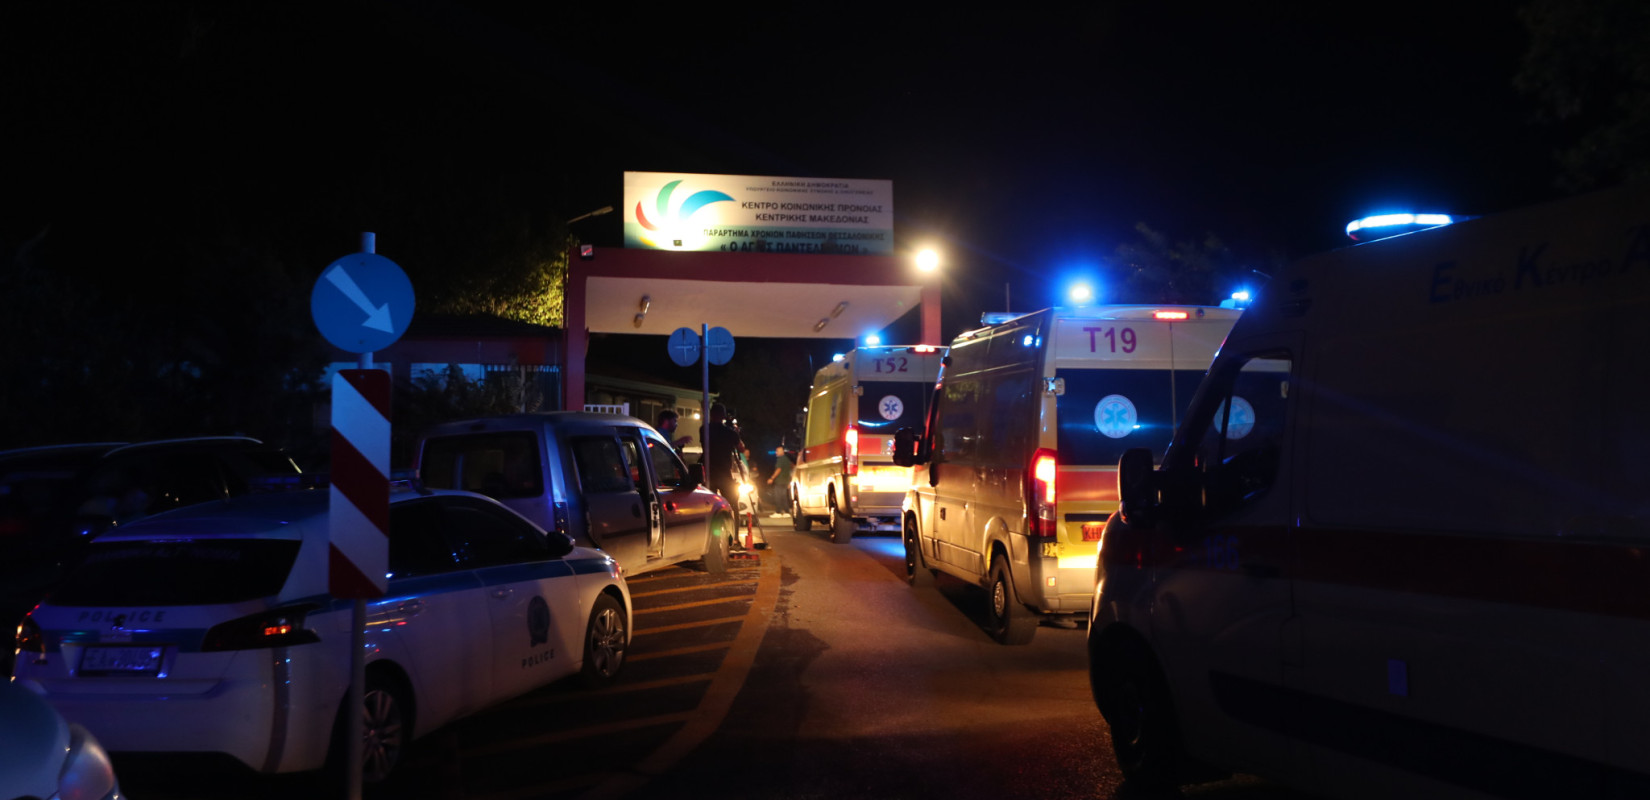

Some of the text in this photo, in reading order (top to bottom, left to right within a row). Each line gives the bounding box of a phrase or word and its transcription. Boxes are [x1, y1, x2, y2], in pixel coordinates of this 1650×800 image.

[742, 202, 883, 213] ΚΕΝΤΡΟ ΚΟΙΝΩΝΙΚΗΣ ΠΡΟΝΟΙΑΣ
[755, 213, 869, 224] ΚΕΝΤΡΙΚΗΣ ΜΑΚΕΔΟΝΙΑΣ
[703, 229, 749, 238] ΠΑΡΑΡΤΗΜΑ
[740, 241, 774, 253] ΑΓΣ
[1083, 326, 1137, 353] T19
[872, 356, 908, 374] T52
[79, 610, 166, 623] POLICE
[522, 648, 555, 668] POLICE
